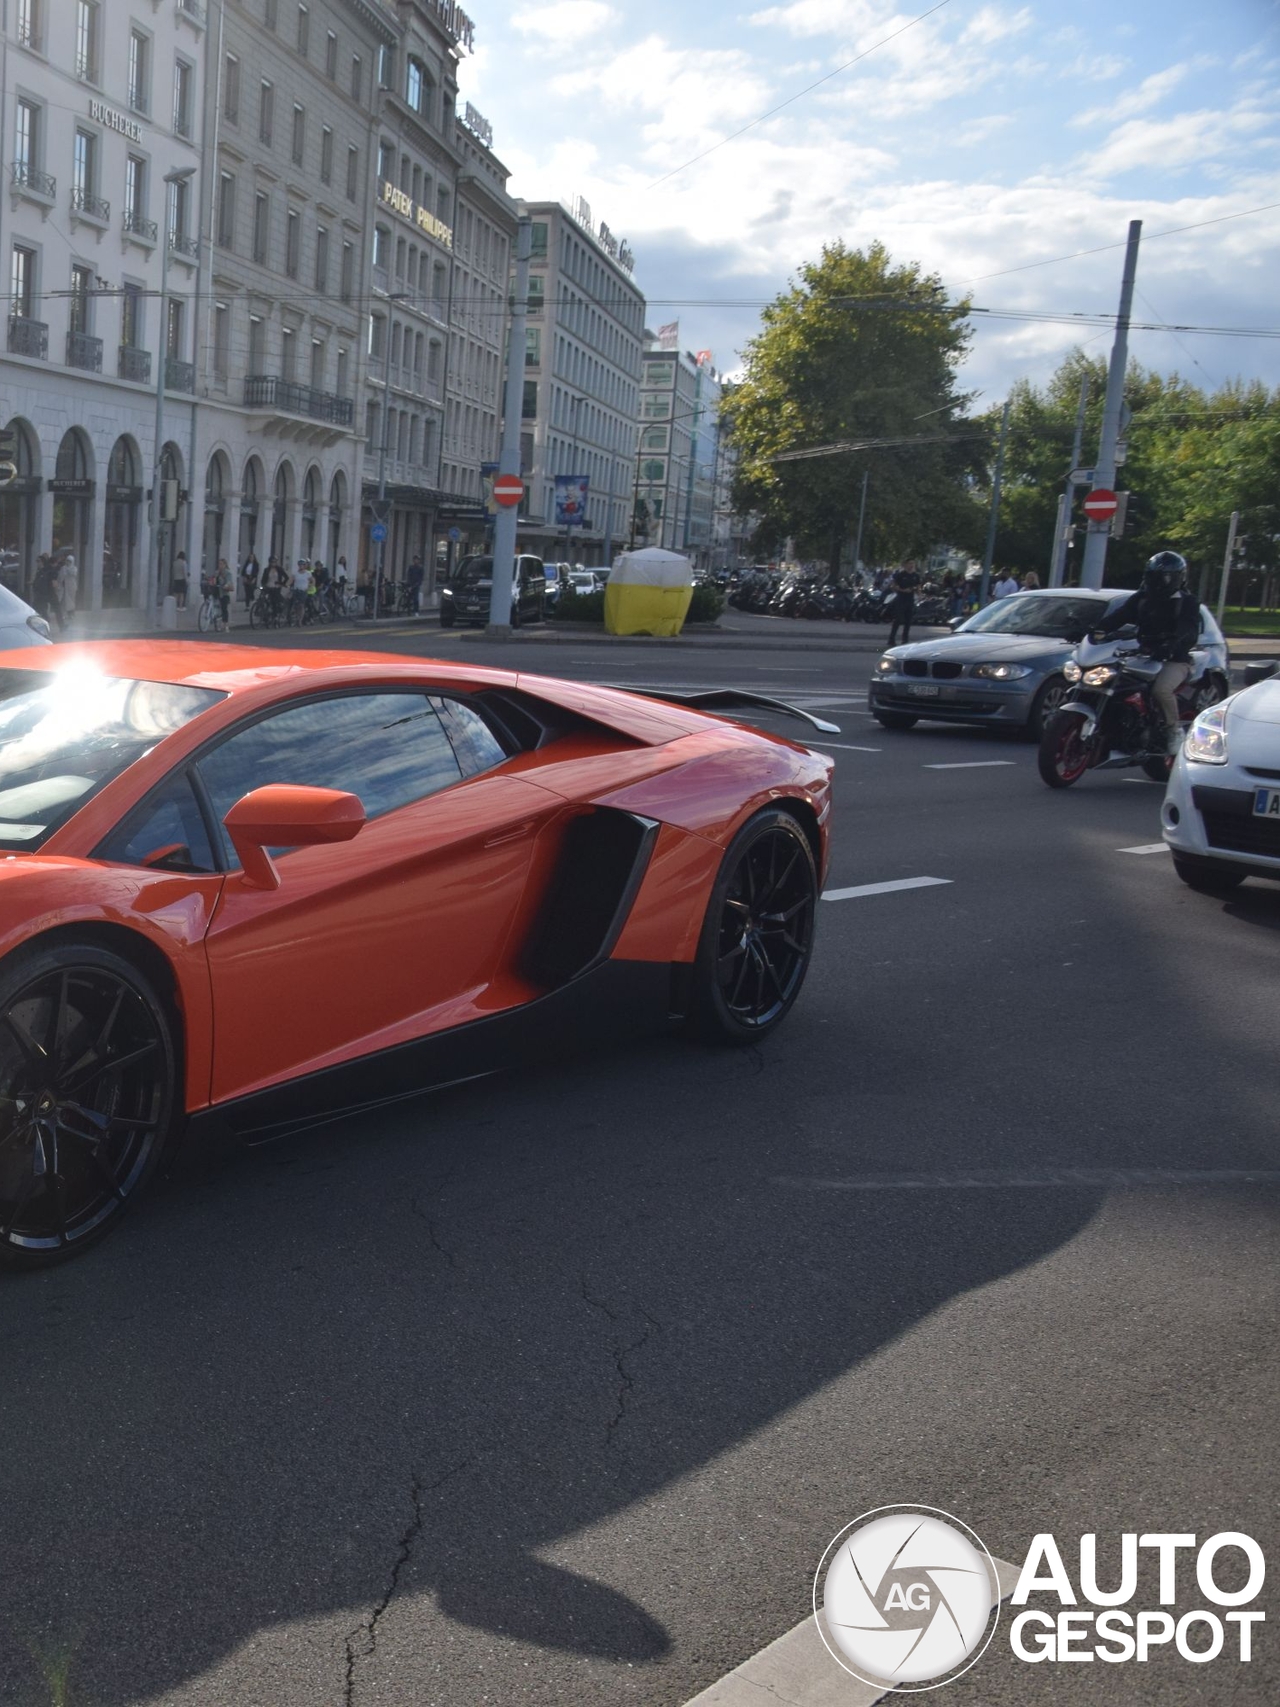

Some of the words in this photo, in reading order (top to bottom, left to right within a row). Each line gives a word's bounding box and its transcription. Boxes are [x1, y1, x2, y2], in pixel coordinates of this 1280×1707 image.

[90, 100, 143, 143] BUCHERER
[384, 181, 413, 219] PATEK
[417, 206, 453, 248] PHILIPPE
